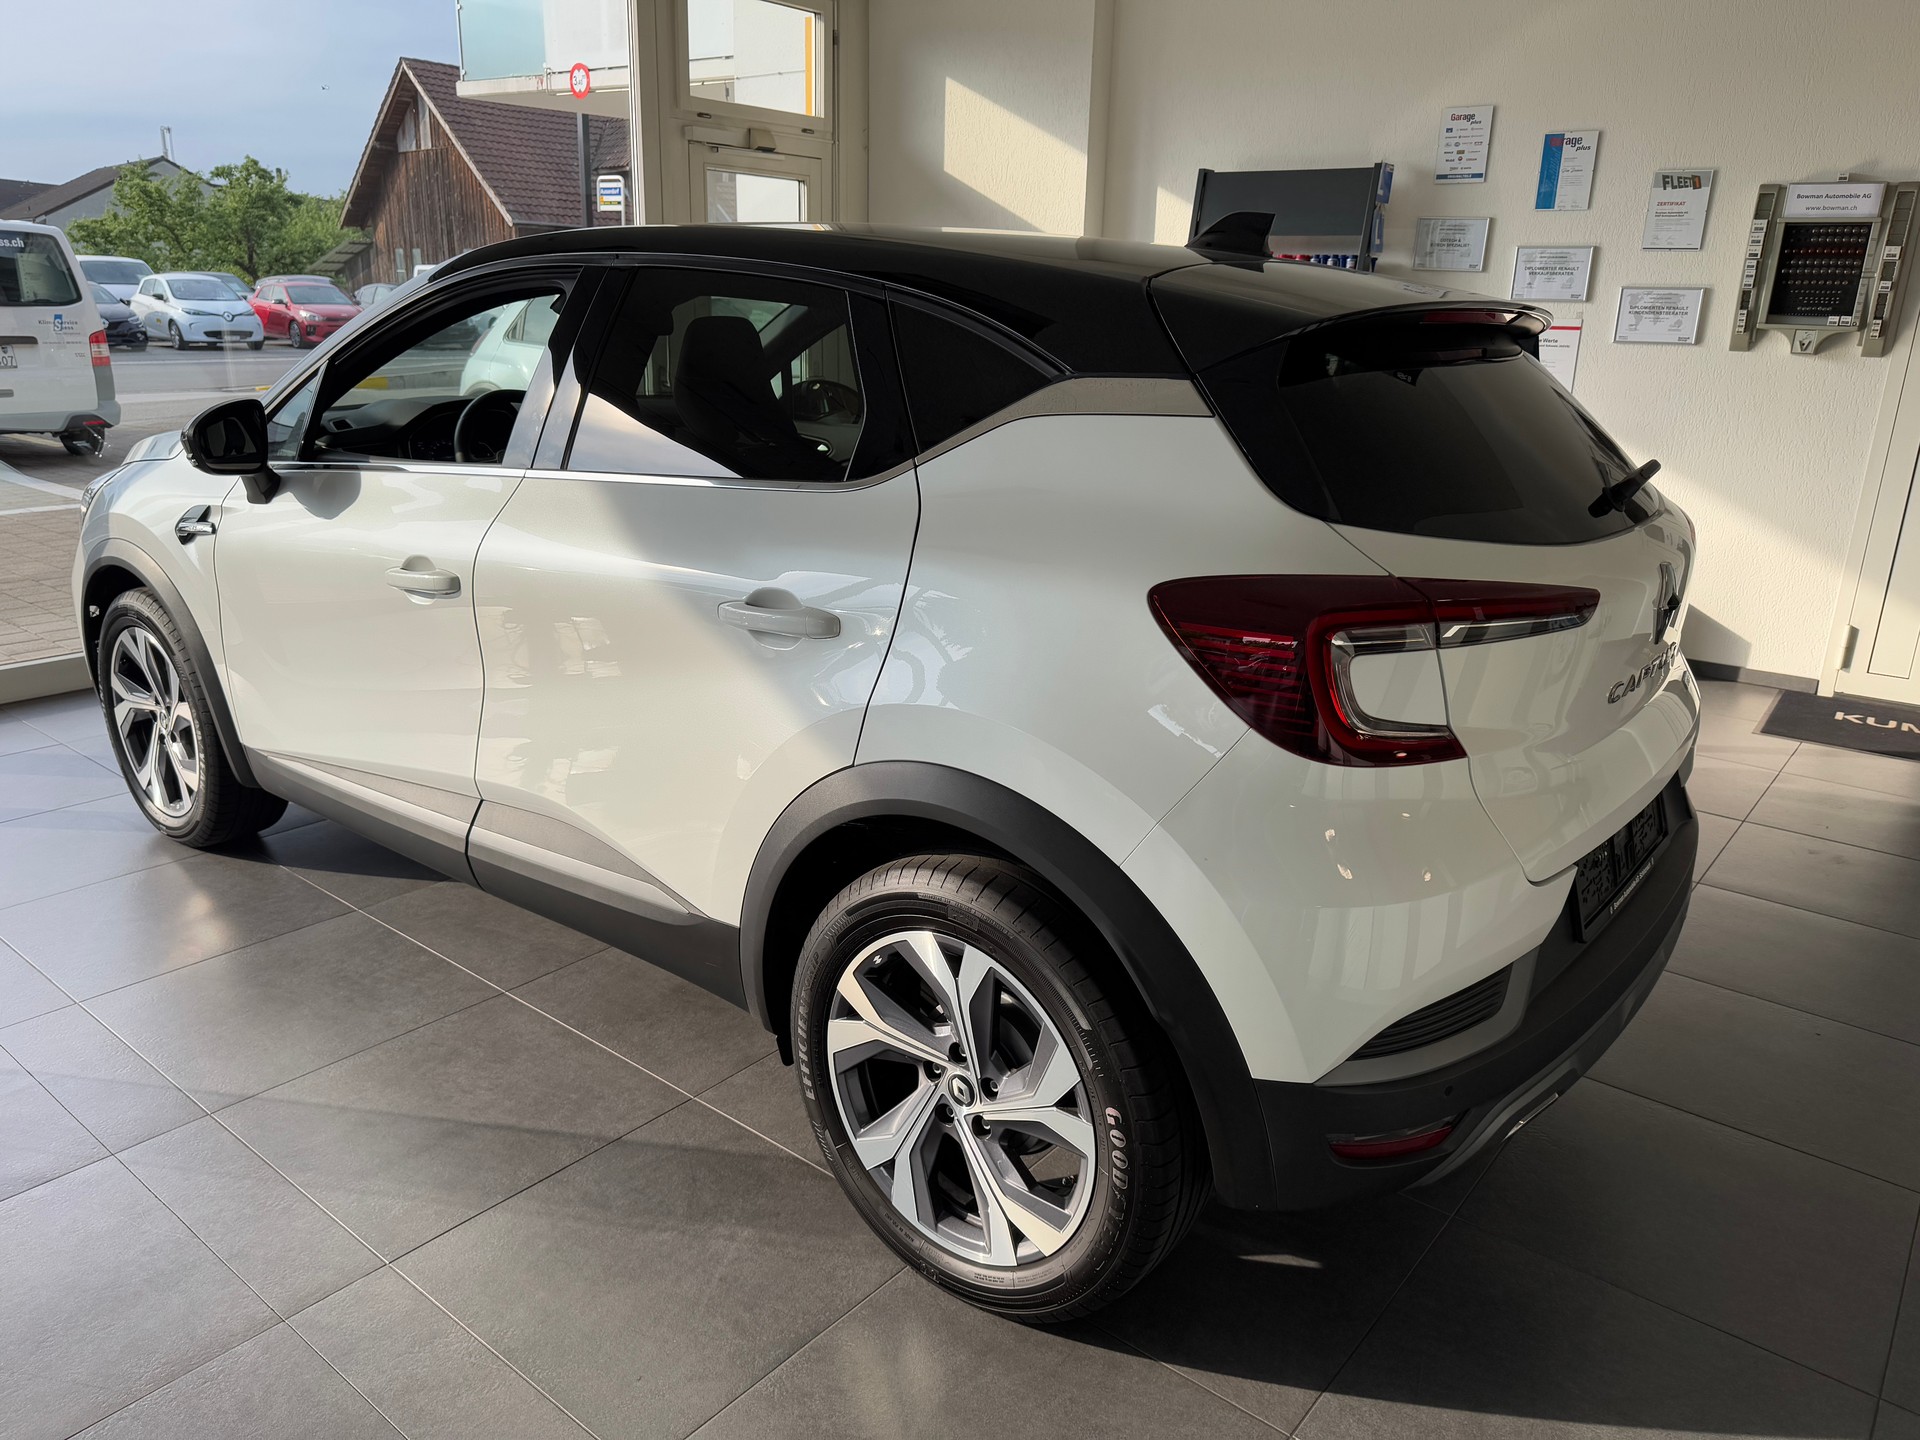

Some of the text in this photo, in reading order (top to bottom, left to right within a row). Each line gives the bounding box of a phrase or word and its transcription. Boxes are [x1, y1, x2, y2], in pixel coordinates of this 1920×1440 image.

[1451, 113, 1475, 122] Garage
[1607, 641, 1677, 704] CAPTUR
[1086, 1106, 1129, 1272] GOODYEAR
